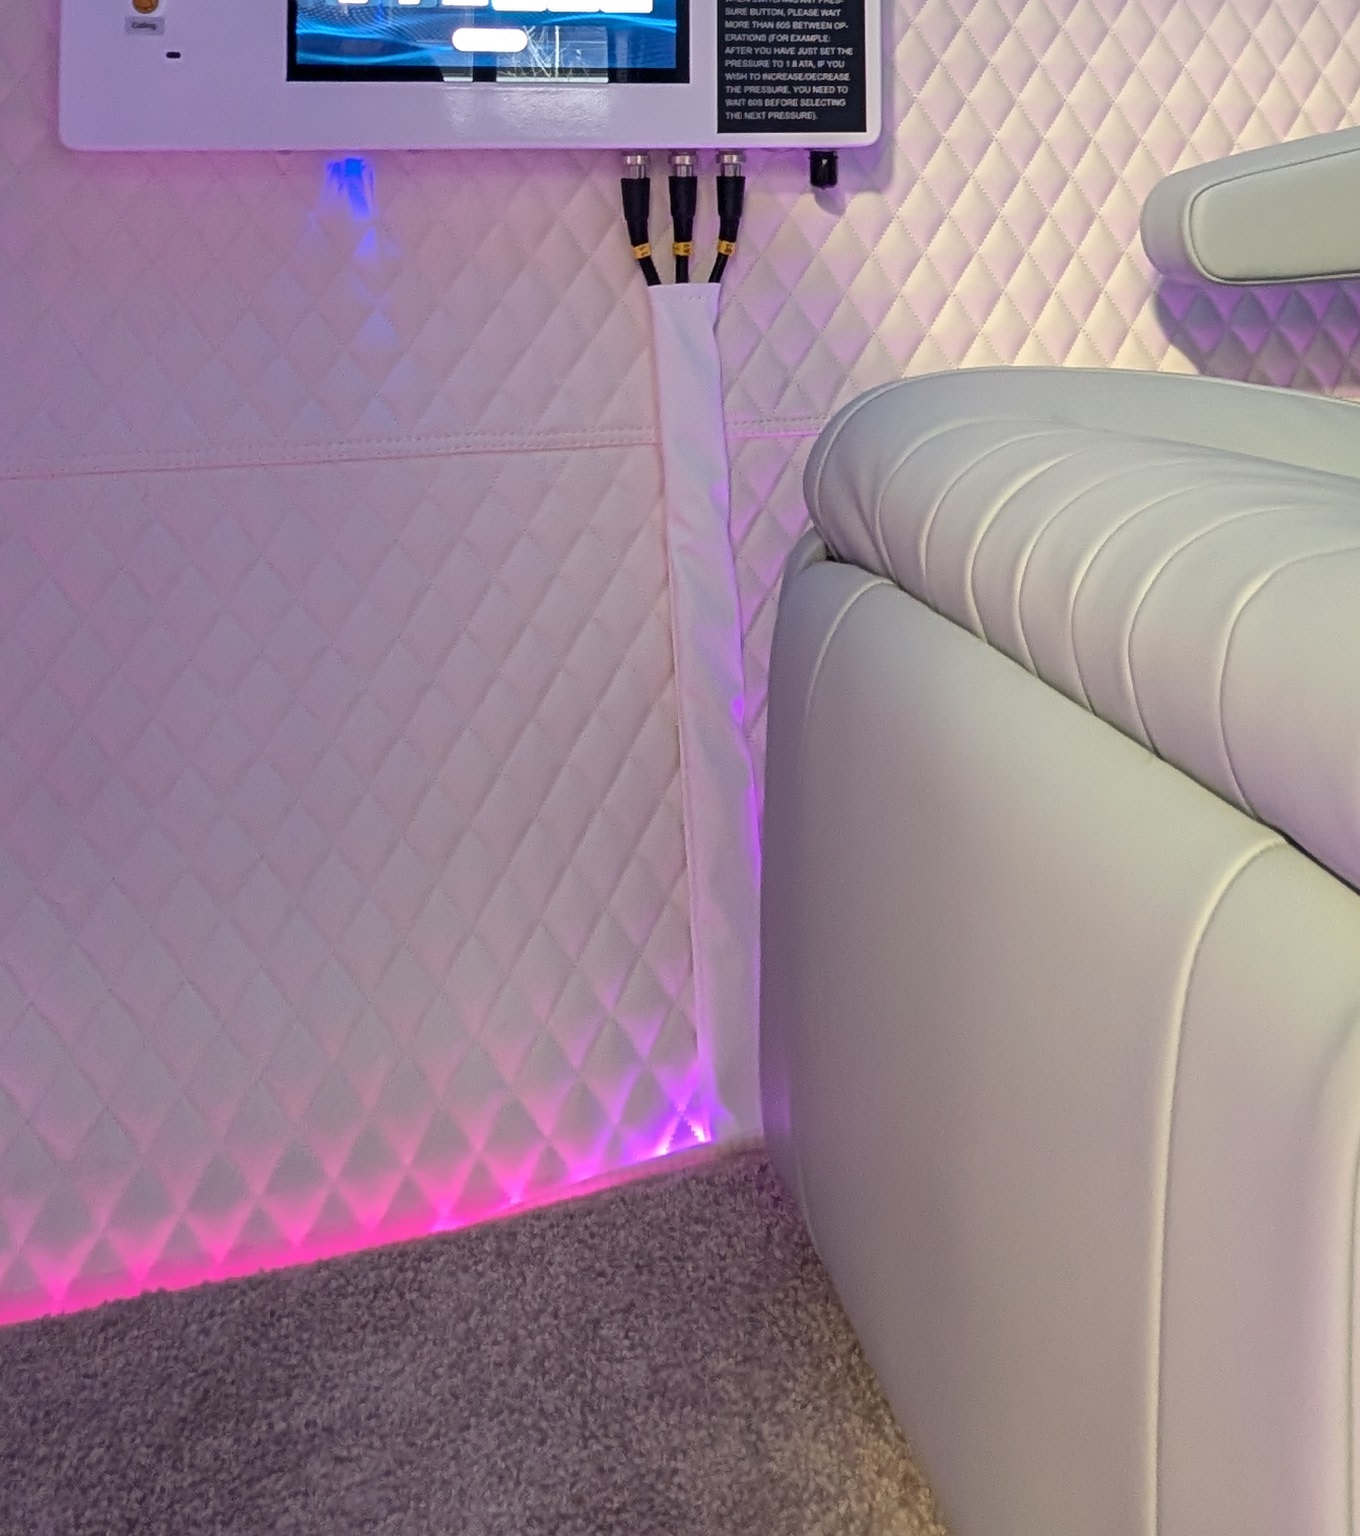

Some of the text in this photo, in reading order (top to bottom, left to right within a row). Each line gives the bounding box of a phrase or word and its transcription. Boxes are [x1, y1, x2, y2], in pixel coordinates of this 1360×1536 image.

[725, 8, 747, 16] SURE
[787, 9, 819, 17] PLEASE
[820, 9, 841, 17] WAIT
[725, 21, 750, 29] MORE
[792, 22, 832, 30] BETWEEN
[834, 22, 848, 30] OP-
[725, 34, 766, 42] ERATIONS
[768, 35, 789, 43] (FOR
[725, 47, 752, 55] AFTER
[754, 47, 772, 55] YOU
[837, 48, 853, 56] THE
[725, 60, 770, 68] PRESSURE
[772, 60, 783, 68] TO
[725, 85, 742, 93] THE
[792, 86, 810, 94] YOU
[812, 86, 835, 94] NEED
[725, 98, 746, 106] WAIT
[764, 98, 798, 107] BEFORE
[800, 98, 846, 107] SELECTING
